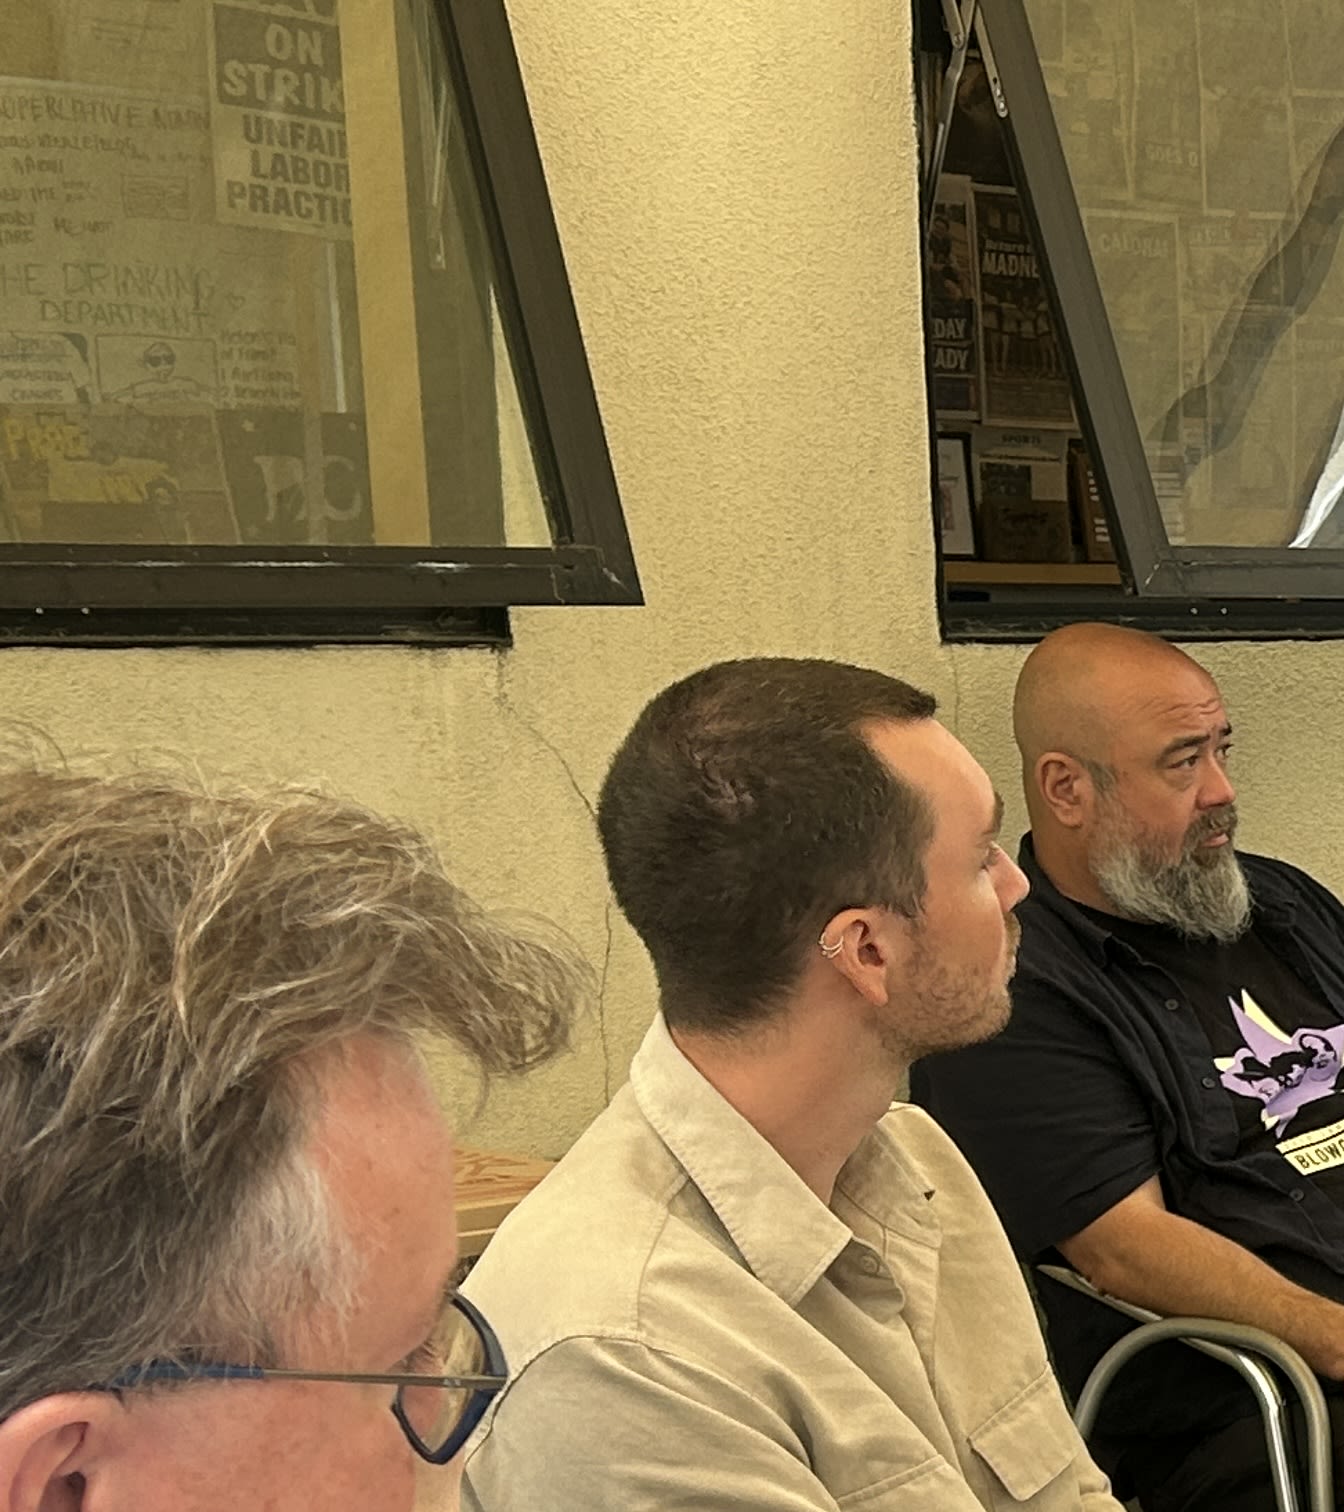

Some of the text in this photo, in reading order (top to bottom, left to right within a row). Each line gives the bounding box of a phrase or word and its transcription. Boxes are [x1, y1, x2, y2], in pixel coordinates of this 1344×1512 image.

[265, 23, 323, 67] ON
[223, 60, 342, 112] STRIK
[250, 147, 350, 194] LABOR
[226, 179, 352, 226] PRACTI
[0, 263, 46, 296] HE
[982, 251, 1040, 278] MADNE
[934, 346, 969, 371] ADY
